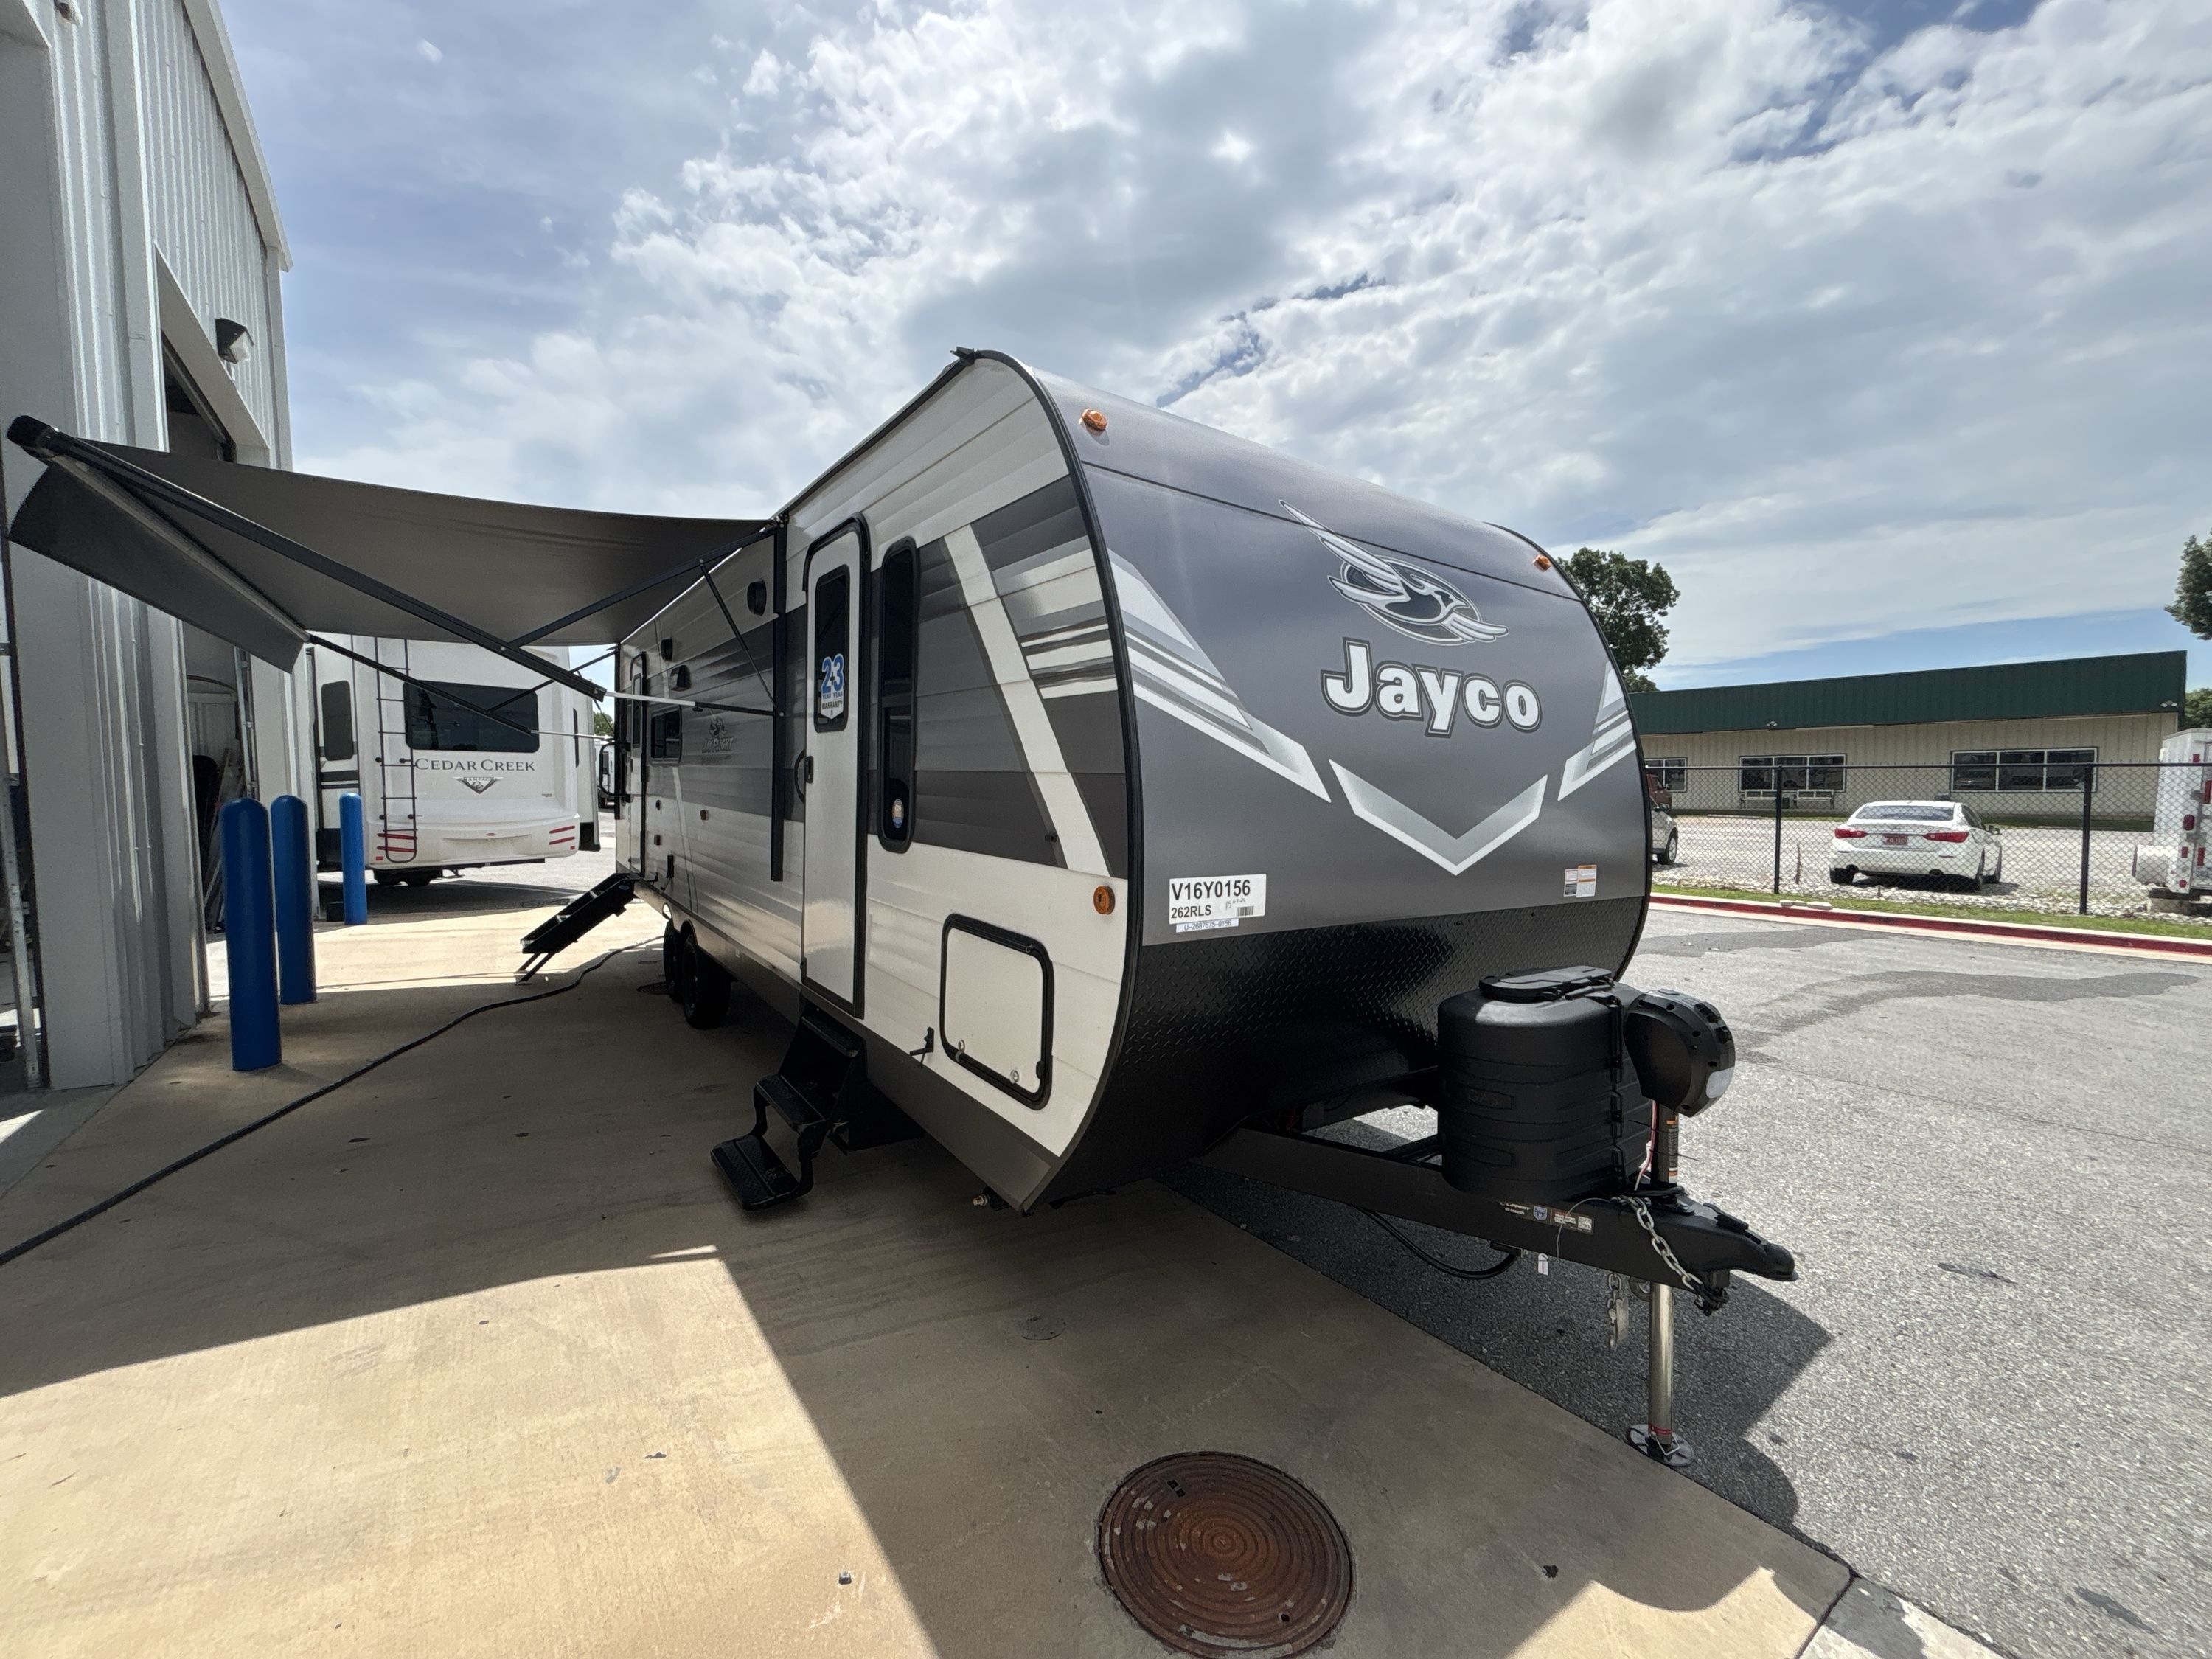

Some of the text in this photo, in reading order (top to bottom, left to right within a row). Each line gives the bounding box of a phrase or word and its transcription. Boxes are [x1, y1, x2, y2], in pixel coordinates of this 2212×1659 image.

[1321, 638, 1542, 737] Jayco
[822, 700, 843, 709] WARRANTY
[415, 758, 535, 771] CEDAR CREEK
[1172, 880, 1251, 900] V16Y0156
[1171, 905, 1211, 919] 262RLS
